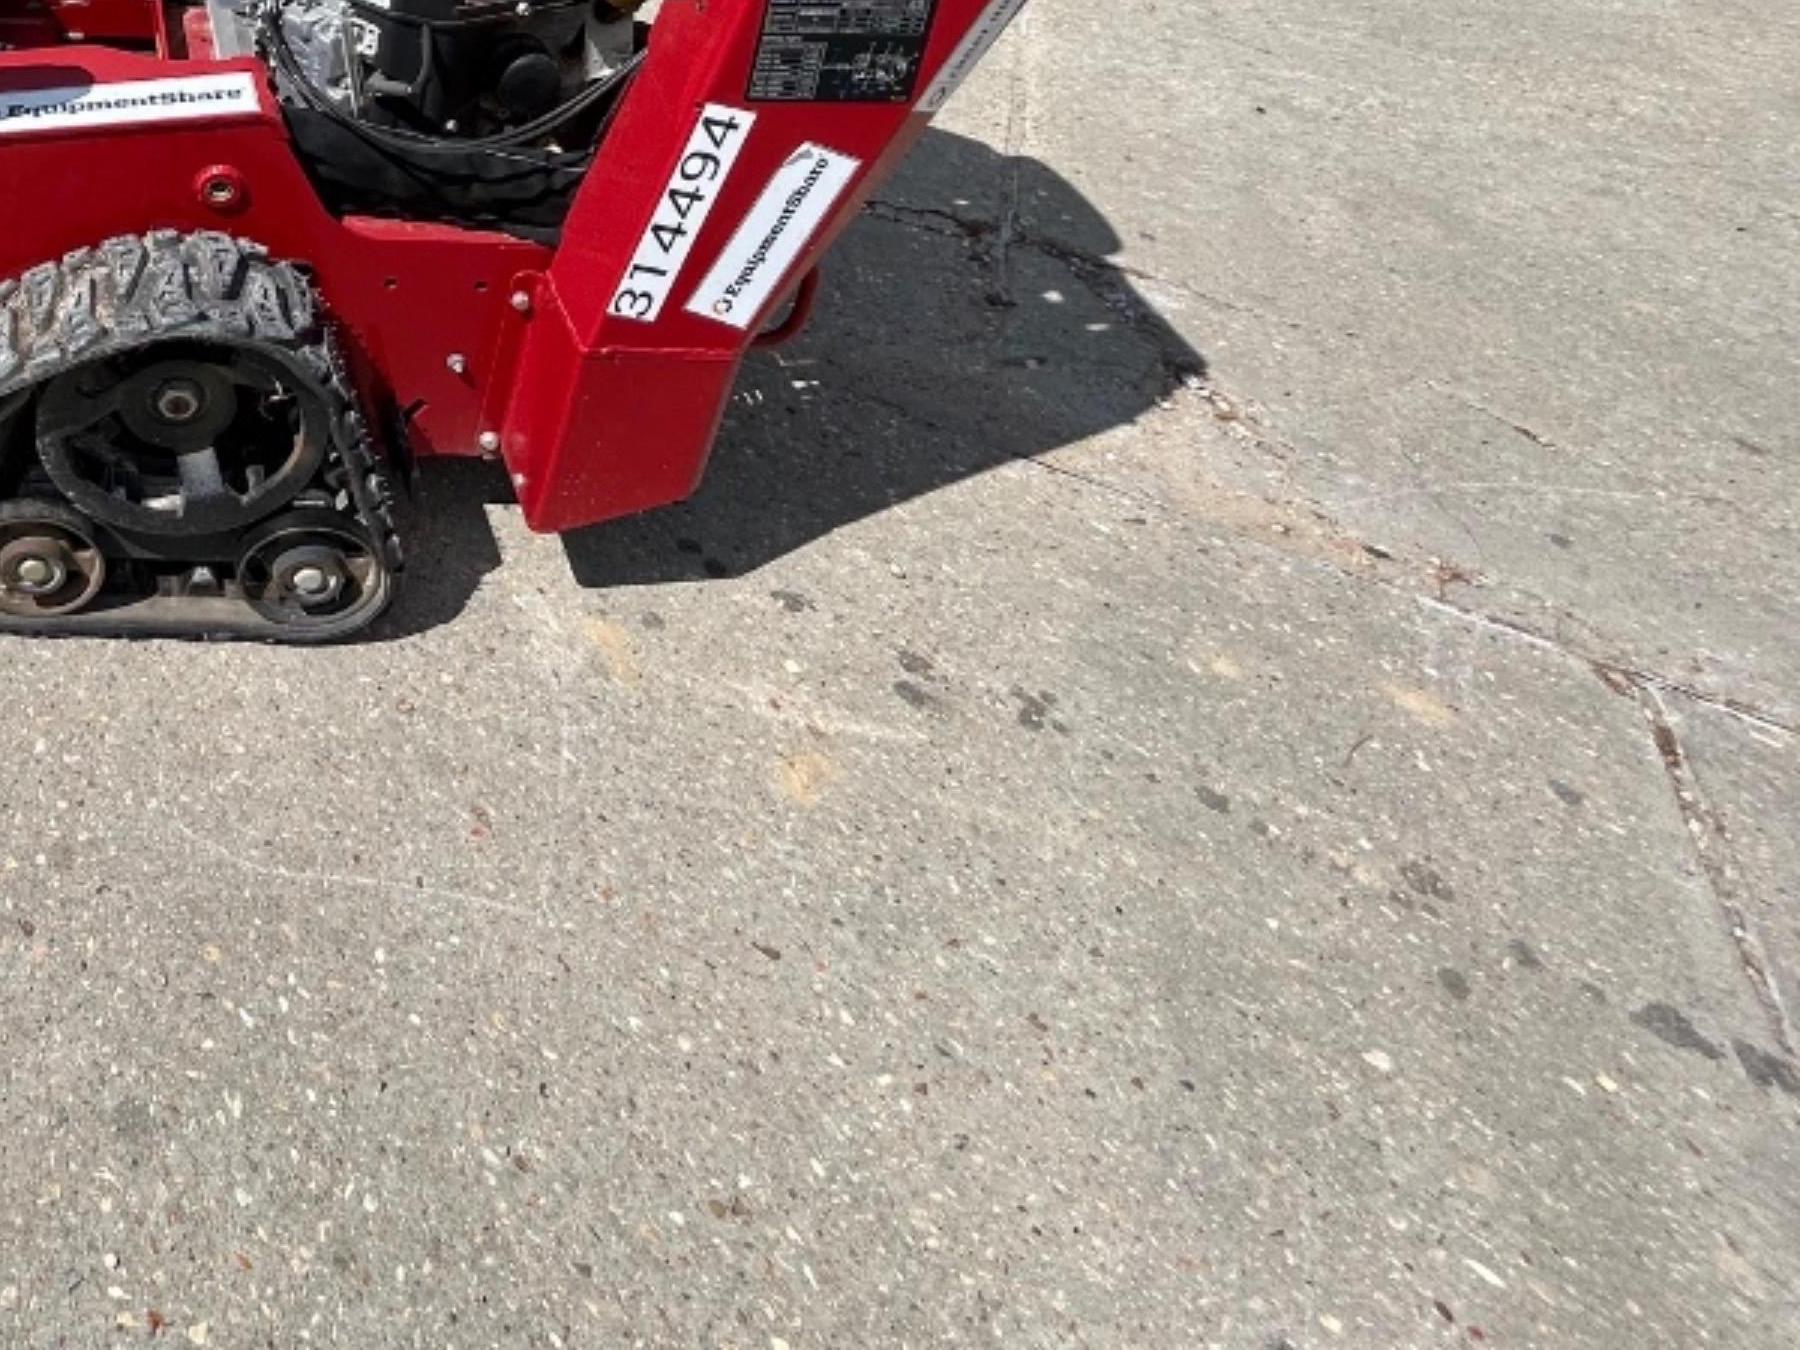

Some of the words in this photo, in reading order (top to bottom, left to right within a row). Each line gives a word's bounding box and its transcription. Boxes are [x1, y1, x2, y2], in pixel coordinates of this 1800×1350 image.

[6, 88, 242, 119] EquipmentShare
[614, 114, 740, 317] 314494
[725, 155, 830, 298] EquipmentShare
